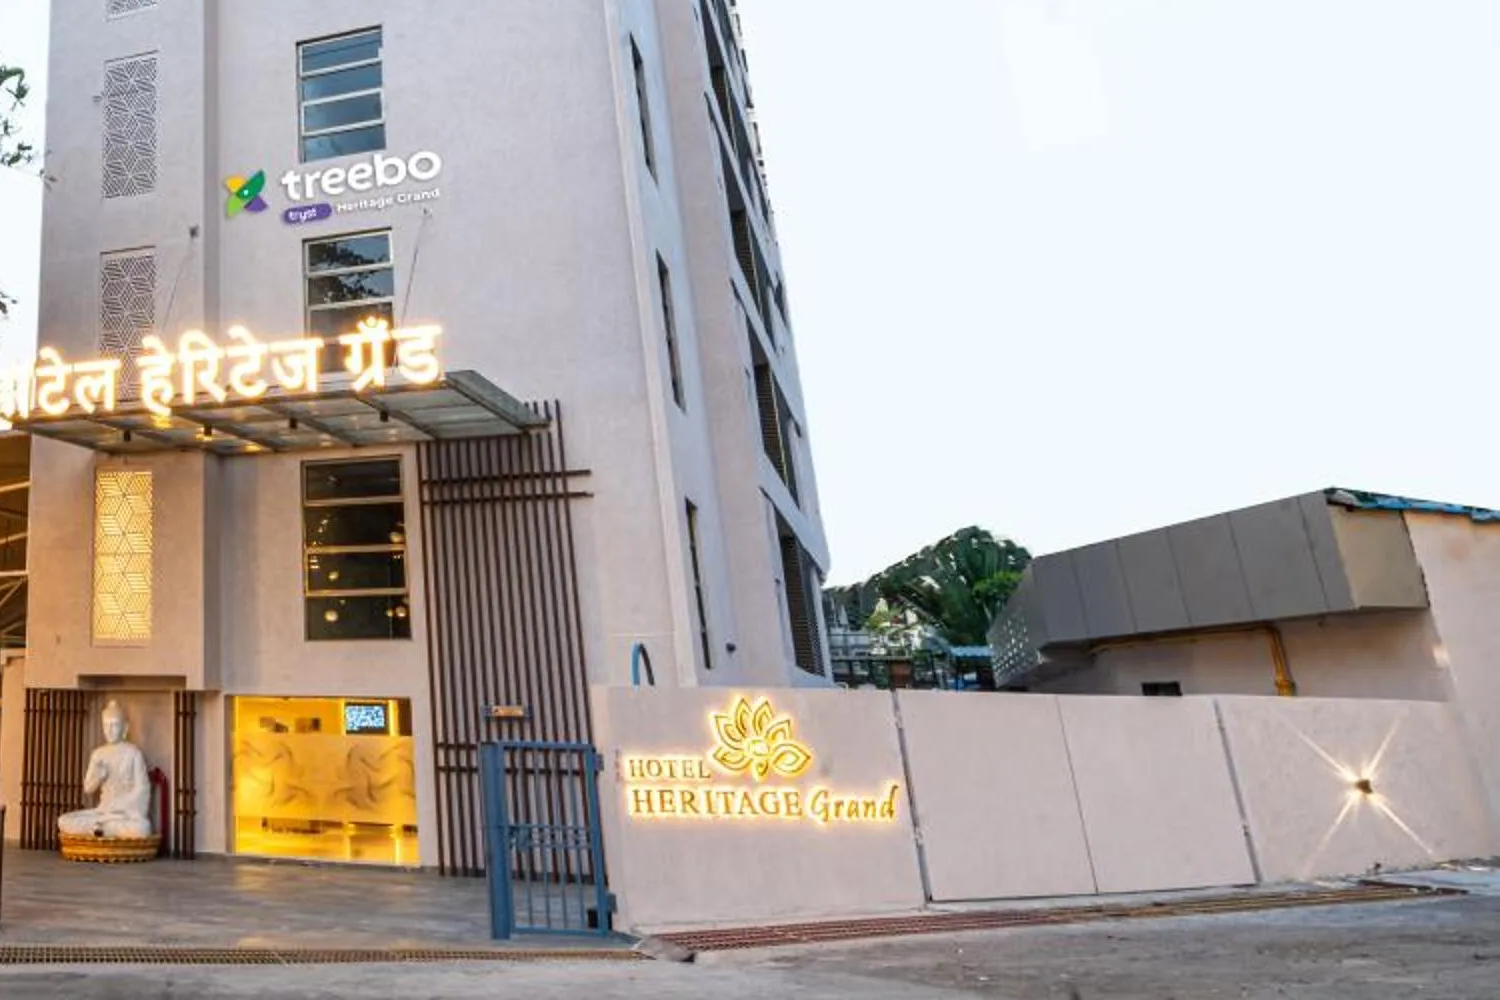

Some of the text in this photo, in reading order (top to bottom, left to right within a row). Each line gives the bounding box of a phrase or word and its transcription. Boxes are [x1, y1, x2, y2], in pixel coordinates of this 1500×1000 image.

[281, 151, 442, 201] treebo
[336, 196, 394, 215] Heritage
[397, 187, 441, 203] Grand
[135, 324, 324, 417] हेरिटेज
[628, 759, 711, 779] HOTEL
[631, 785, 900, 822] HERITAGE Grand
